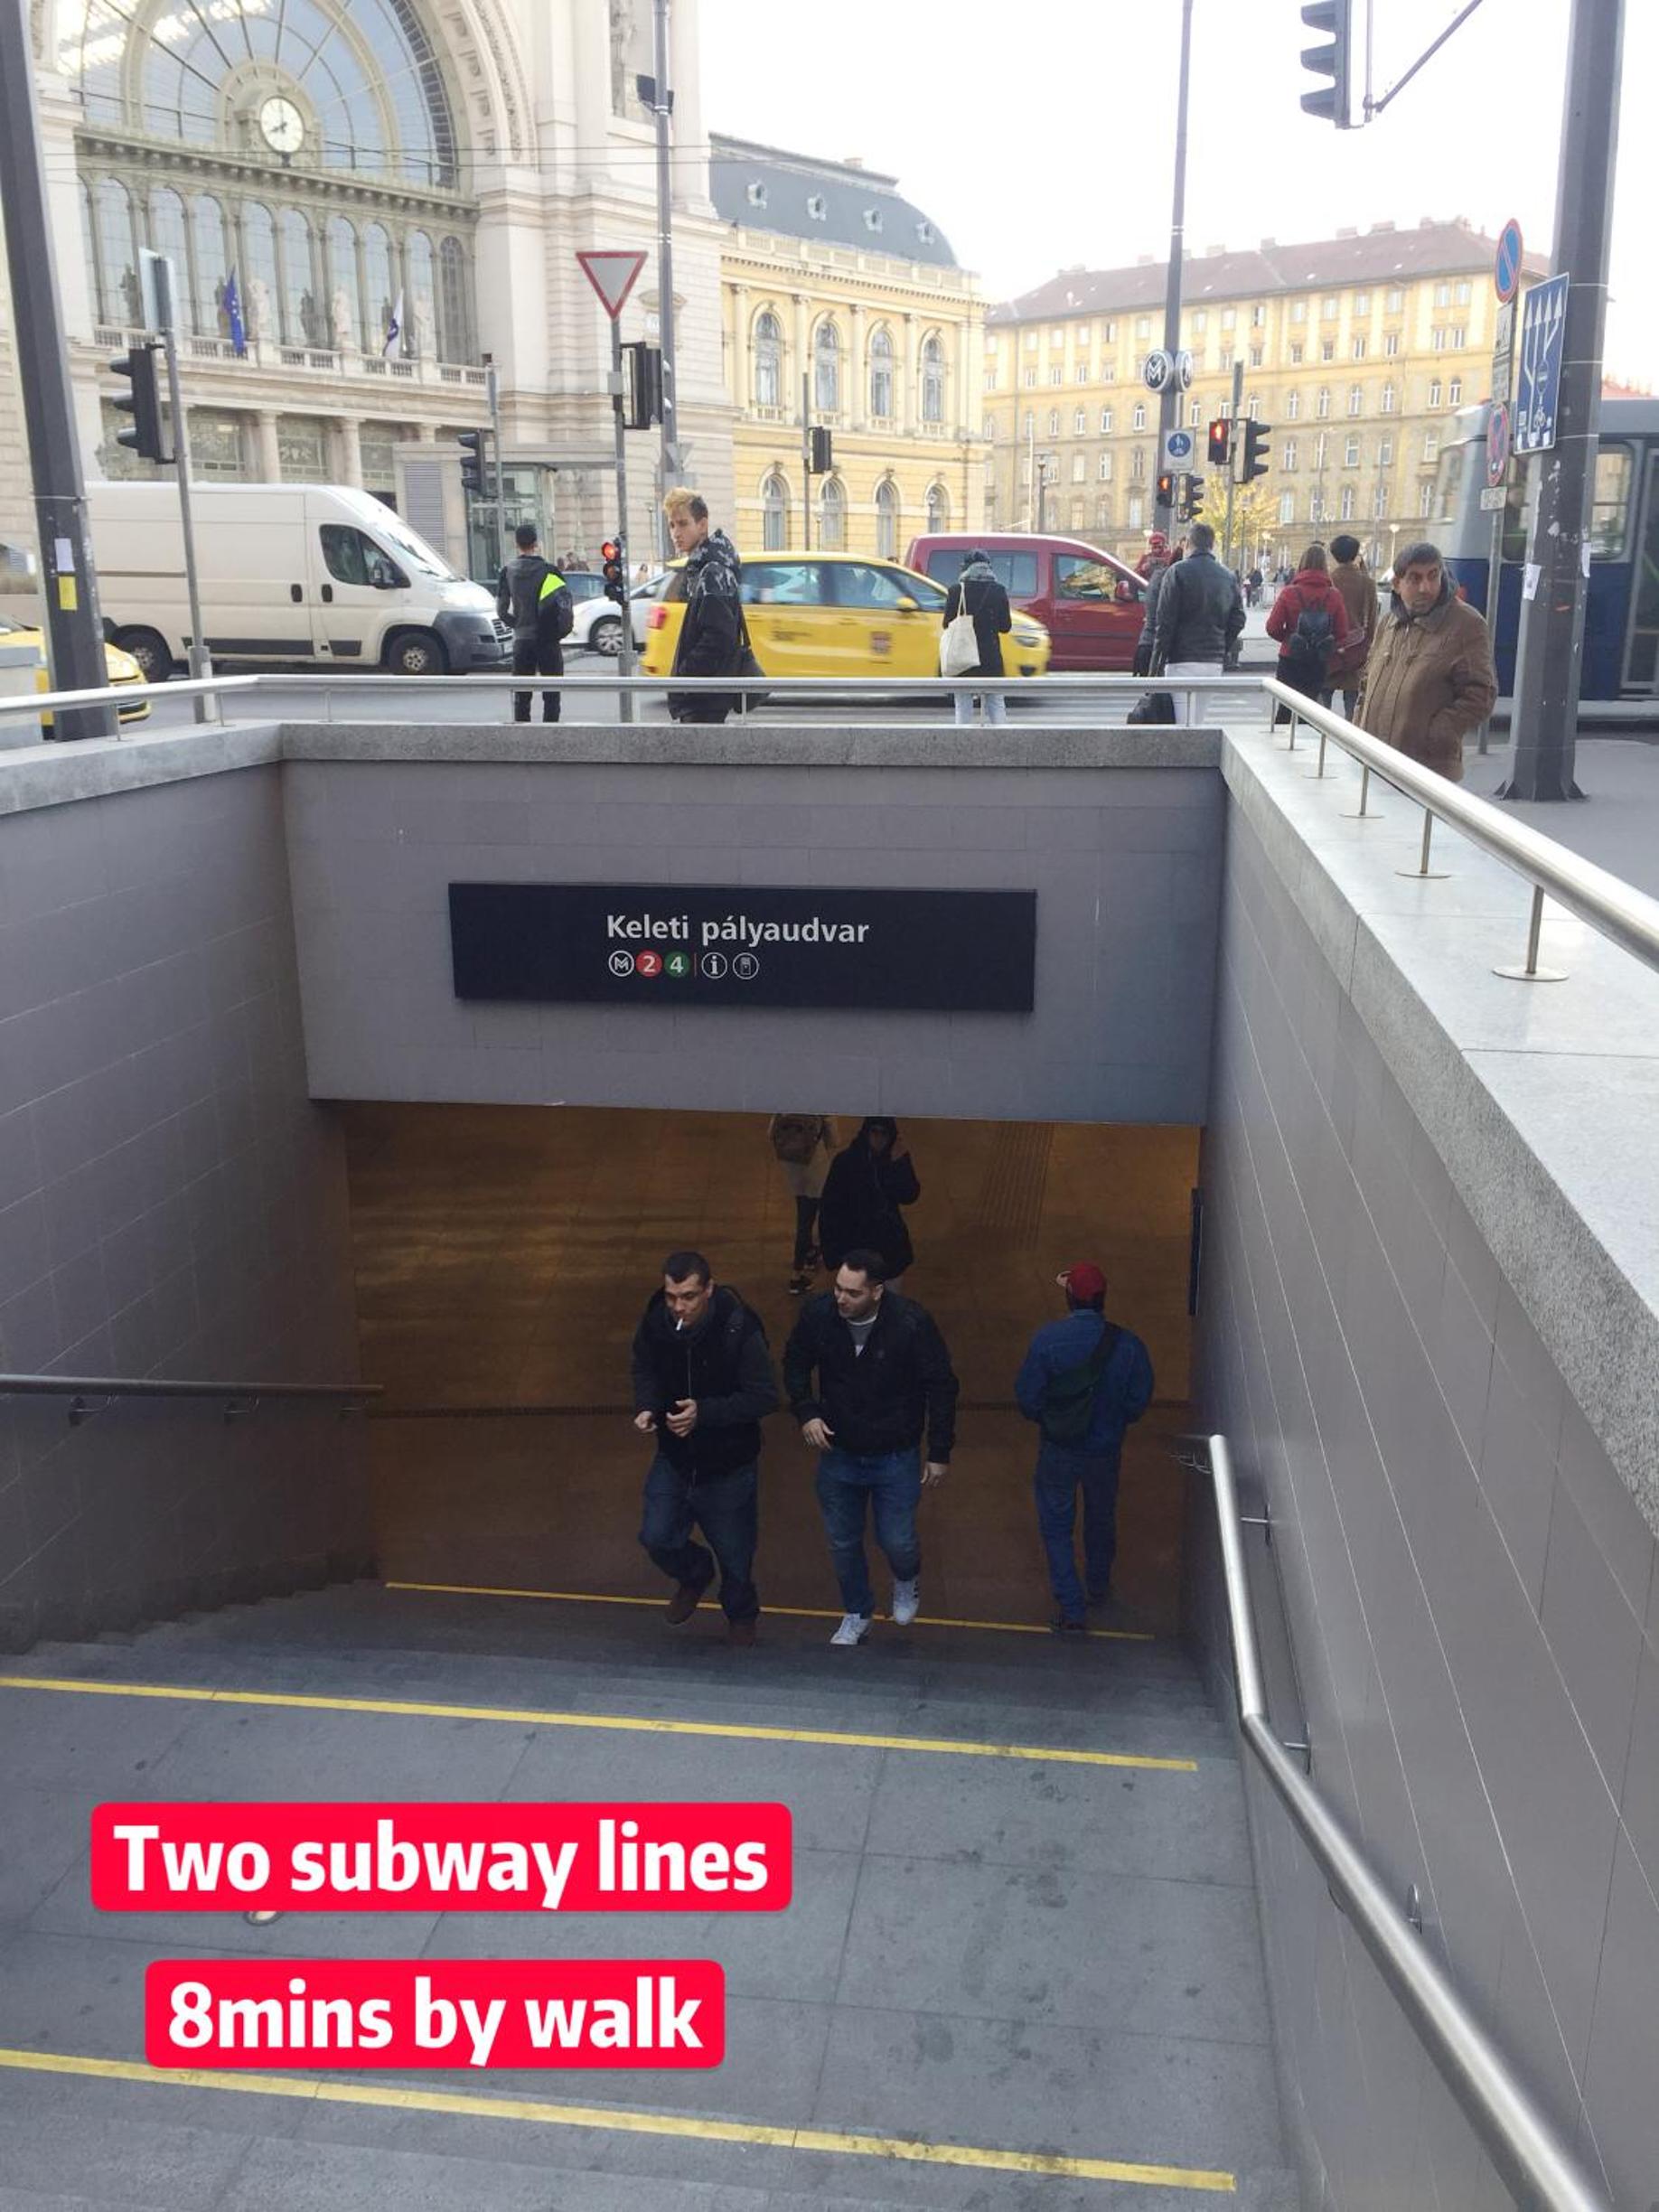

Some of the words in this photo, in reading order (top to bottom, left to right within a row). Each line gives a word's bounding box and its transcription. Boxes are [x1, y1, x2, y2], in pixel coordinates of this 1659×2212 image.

[607, 914, 689, 939] Keleti
[702, 915, 869, 947] pályaudvar
[642, 955, 656, 973] 2
[670, 956, 684, 973] 4
